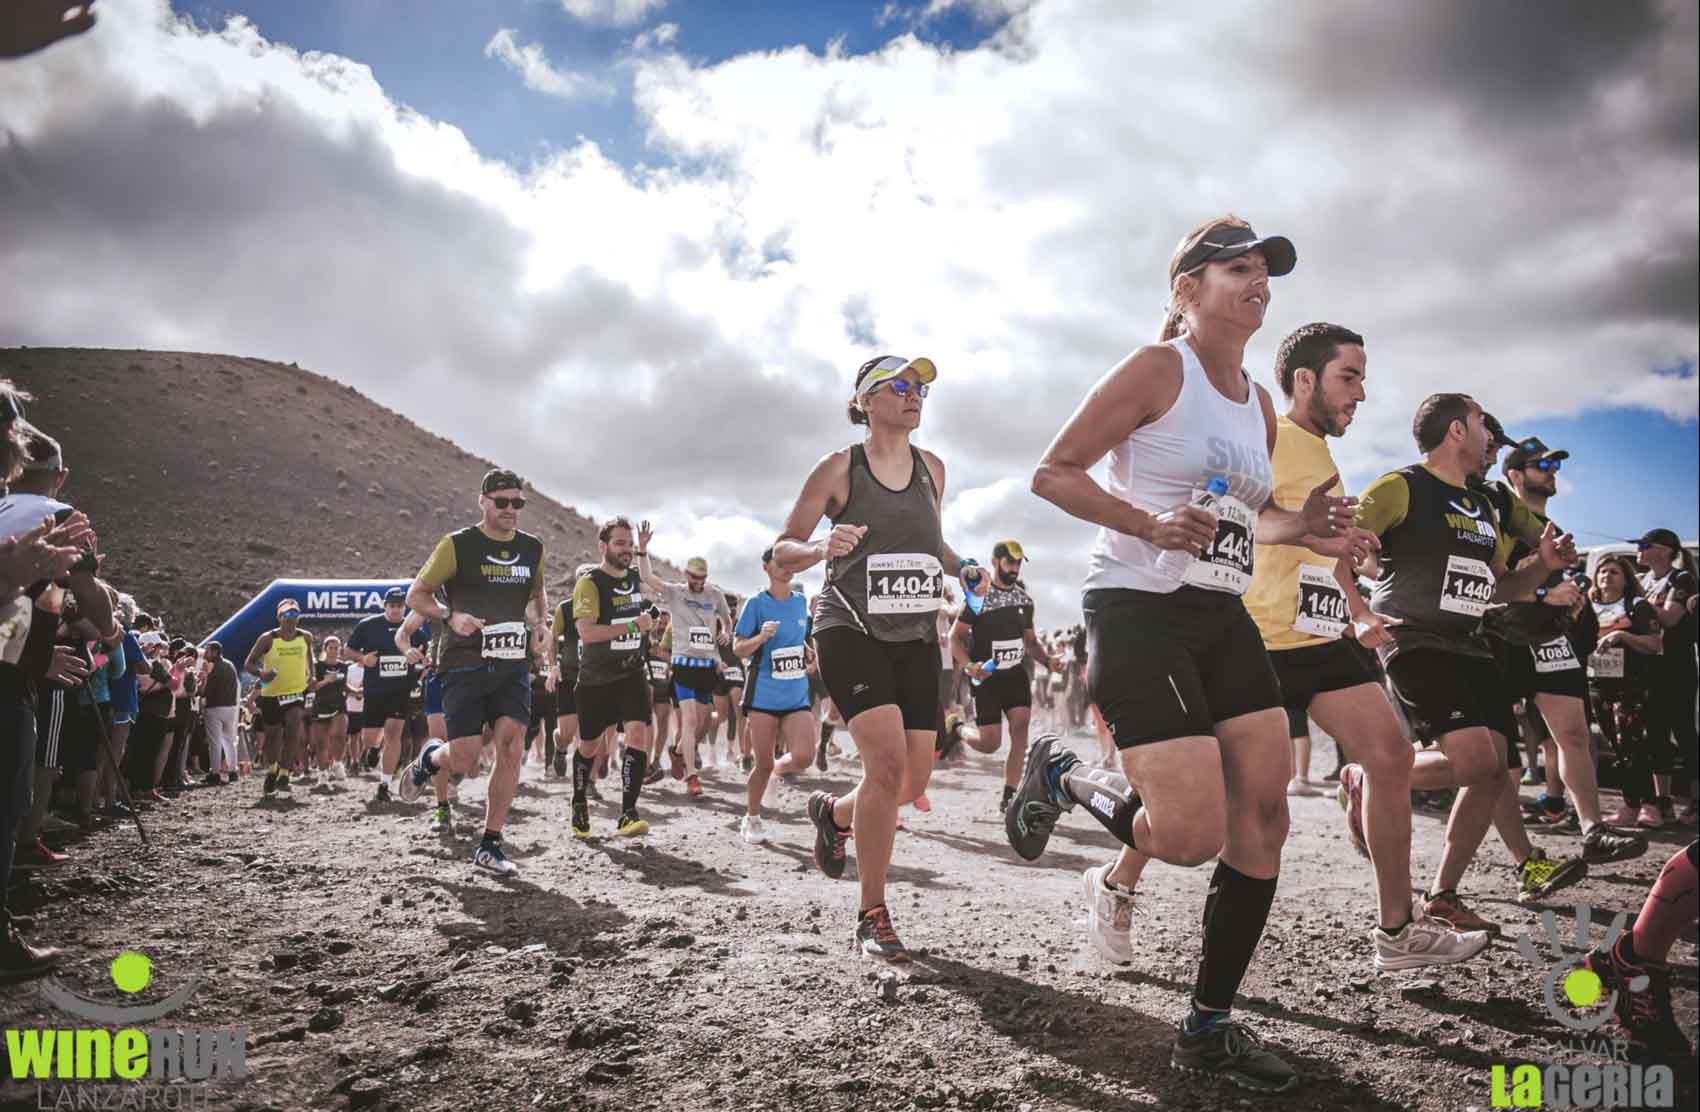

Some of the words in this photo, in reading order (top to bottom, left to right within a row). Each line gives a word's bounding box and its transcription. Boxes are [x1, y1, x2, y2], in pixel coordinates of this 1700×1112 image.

[878, 576, 935, 595] 1404
[1454, 579, 1491, 601] 1440
[307, 592, 385, 608] META
[1308, 593, 1344, 618] 1410
[489, 636, 523, 649] 1114
[1538, 647, 1570, 660] 1088
[778, 659, 804, 671] 1081
